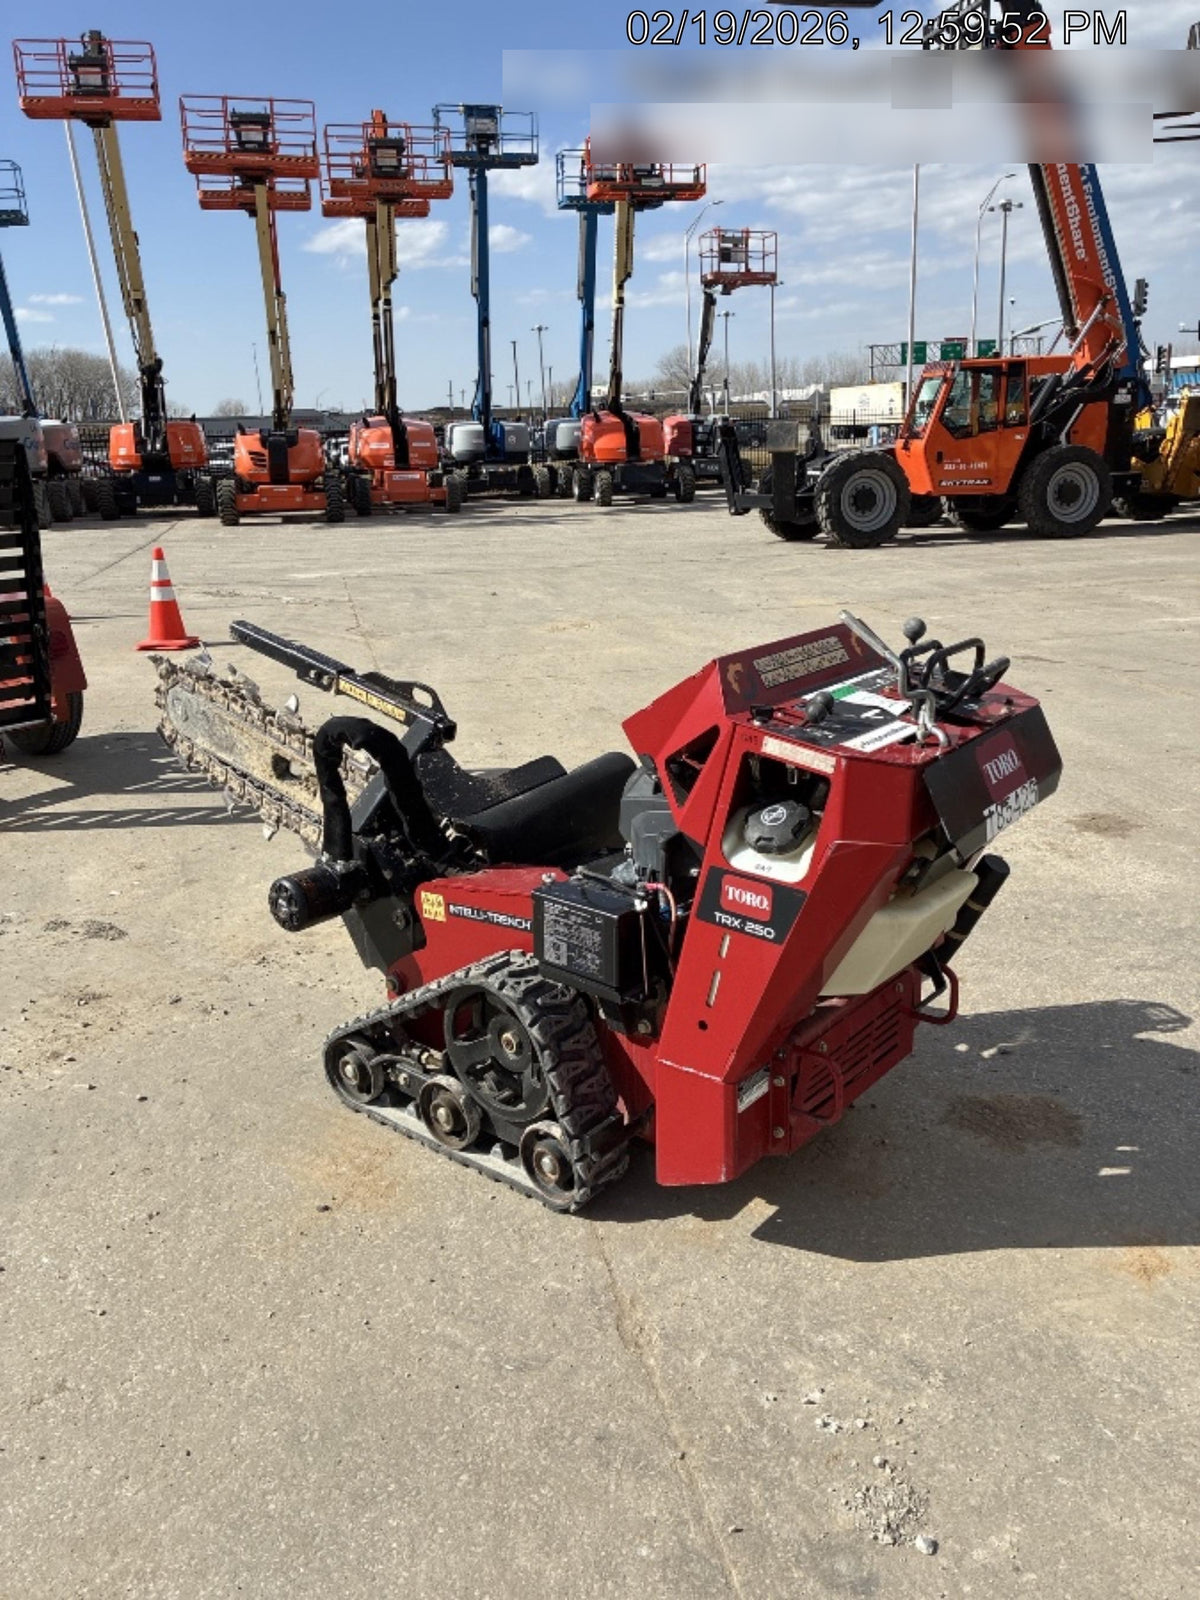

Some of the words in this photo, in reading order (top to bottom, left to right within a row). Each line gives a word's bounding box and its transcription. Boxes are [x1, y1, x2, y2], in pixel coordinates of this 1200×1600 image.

[982, 748, 1021, 785] TORO
[725, 884, 769, 911] TORO
[449, 904, 532, 931] INTELLI-TRENCH
